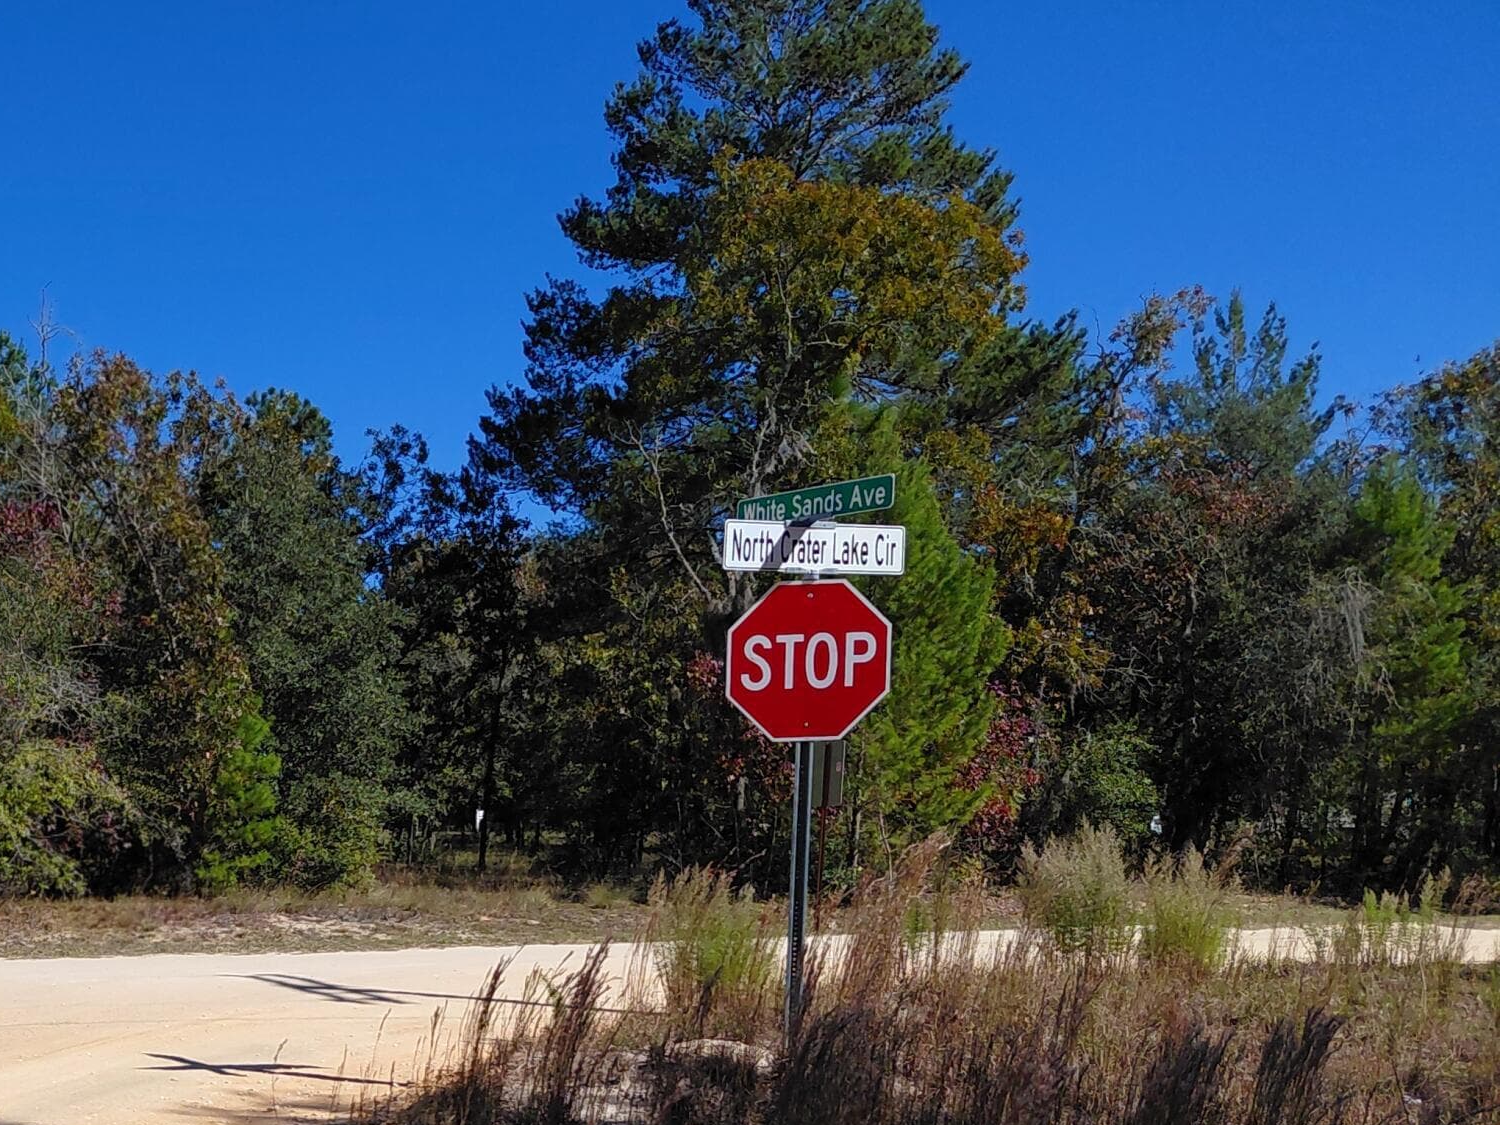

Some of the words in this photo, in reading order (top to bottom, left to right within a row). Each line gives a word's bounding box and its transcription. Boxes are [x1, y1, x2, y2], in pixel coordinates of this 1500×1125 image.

[743, 501, 785, 521] White
[791, 489, 843, 519] Sands
[849, 484, 886, 508] Ave
[731, 528, 774, 563] North
[780, 532, 827, 565] Crater
[832, 532, 869, 566] Lake
[875, 534, 897, 568] Cir
[740, 631, 877, 692] STOP
